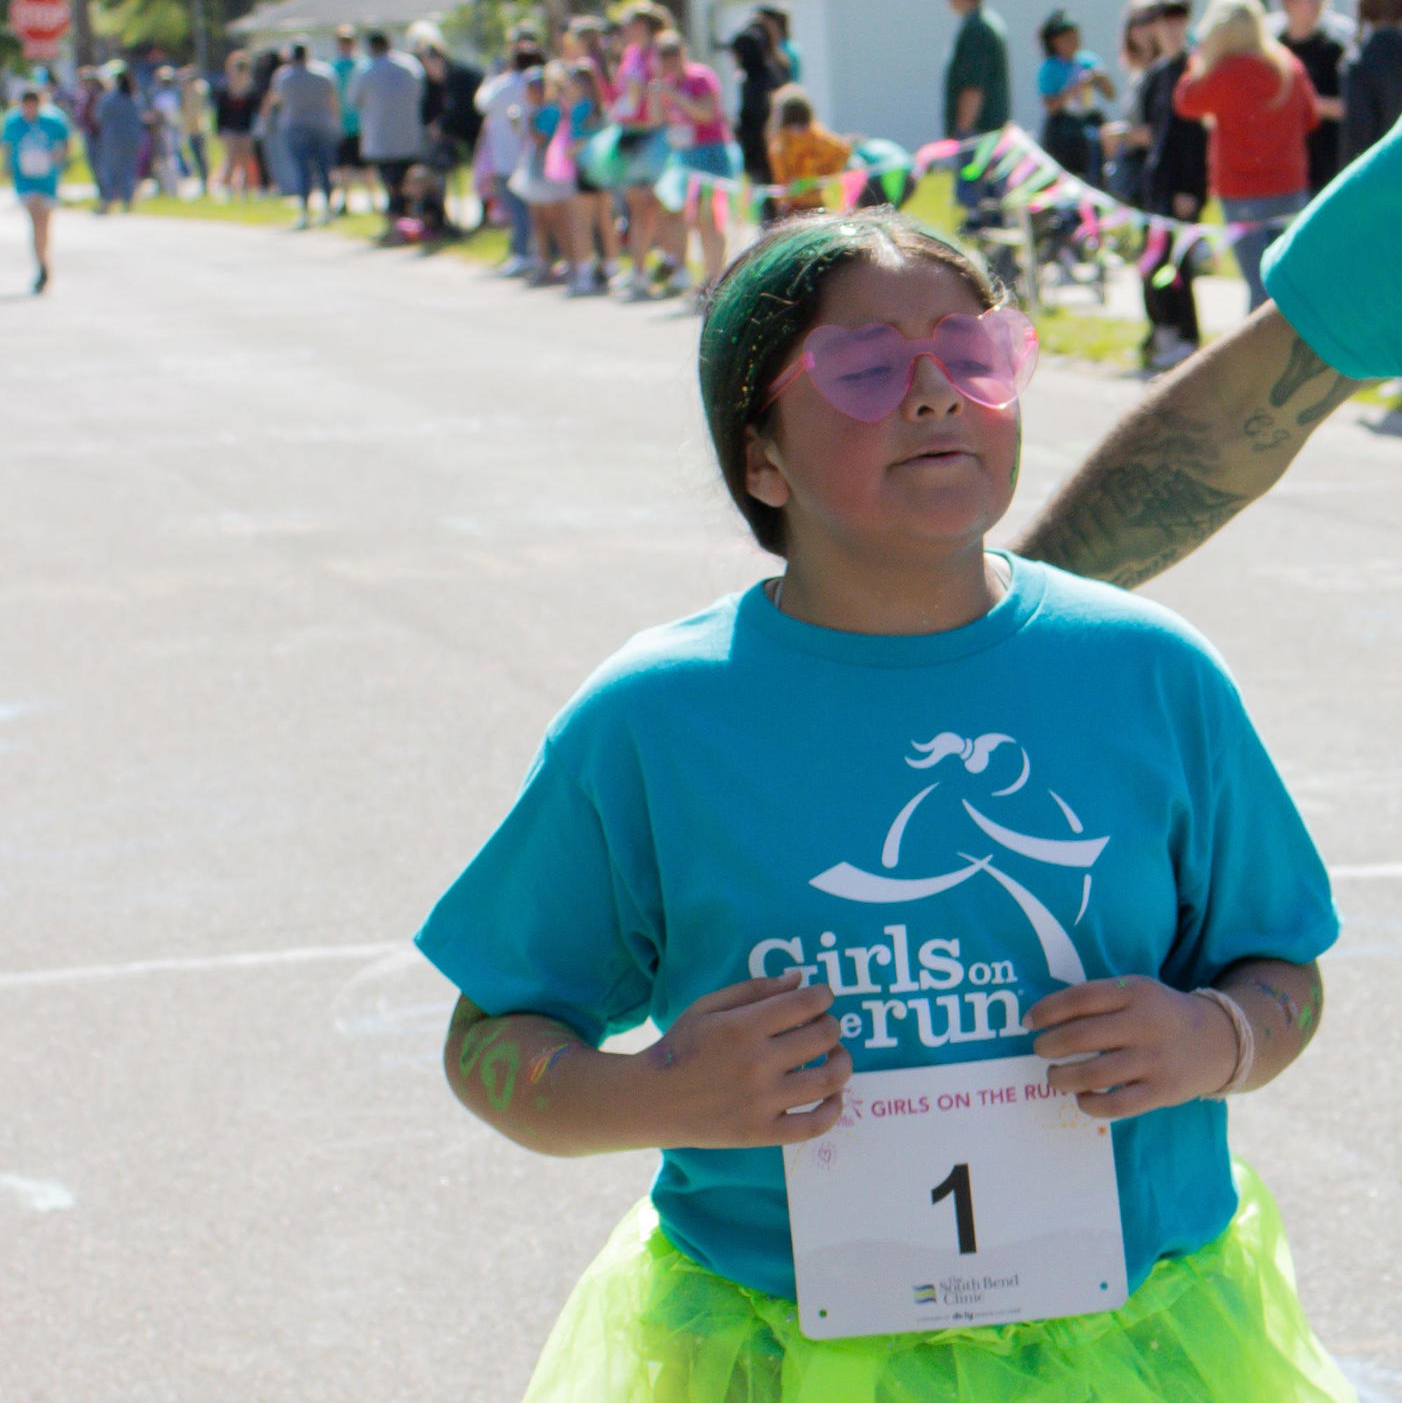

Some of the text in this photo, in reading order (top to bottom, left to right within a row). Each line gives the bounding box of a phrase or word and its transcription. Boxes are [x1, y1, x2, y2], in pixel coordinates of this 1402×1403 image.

[748, 925, 1018, 998] Girls on
[862, 989, 1030, 1049] run
[871, 1096, 930, 1118] GIRLS
[937, 1092, 971, 1112] ON
[977, 1085, 1018, 1105] THE
[930, 1162, 977, 1255] 1
